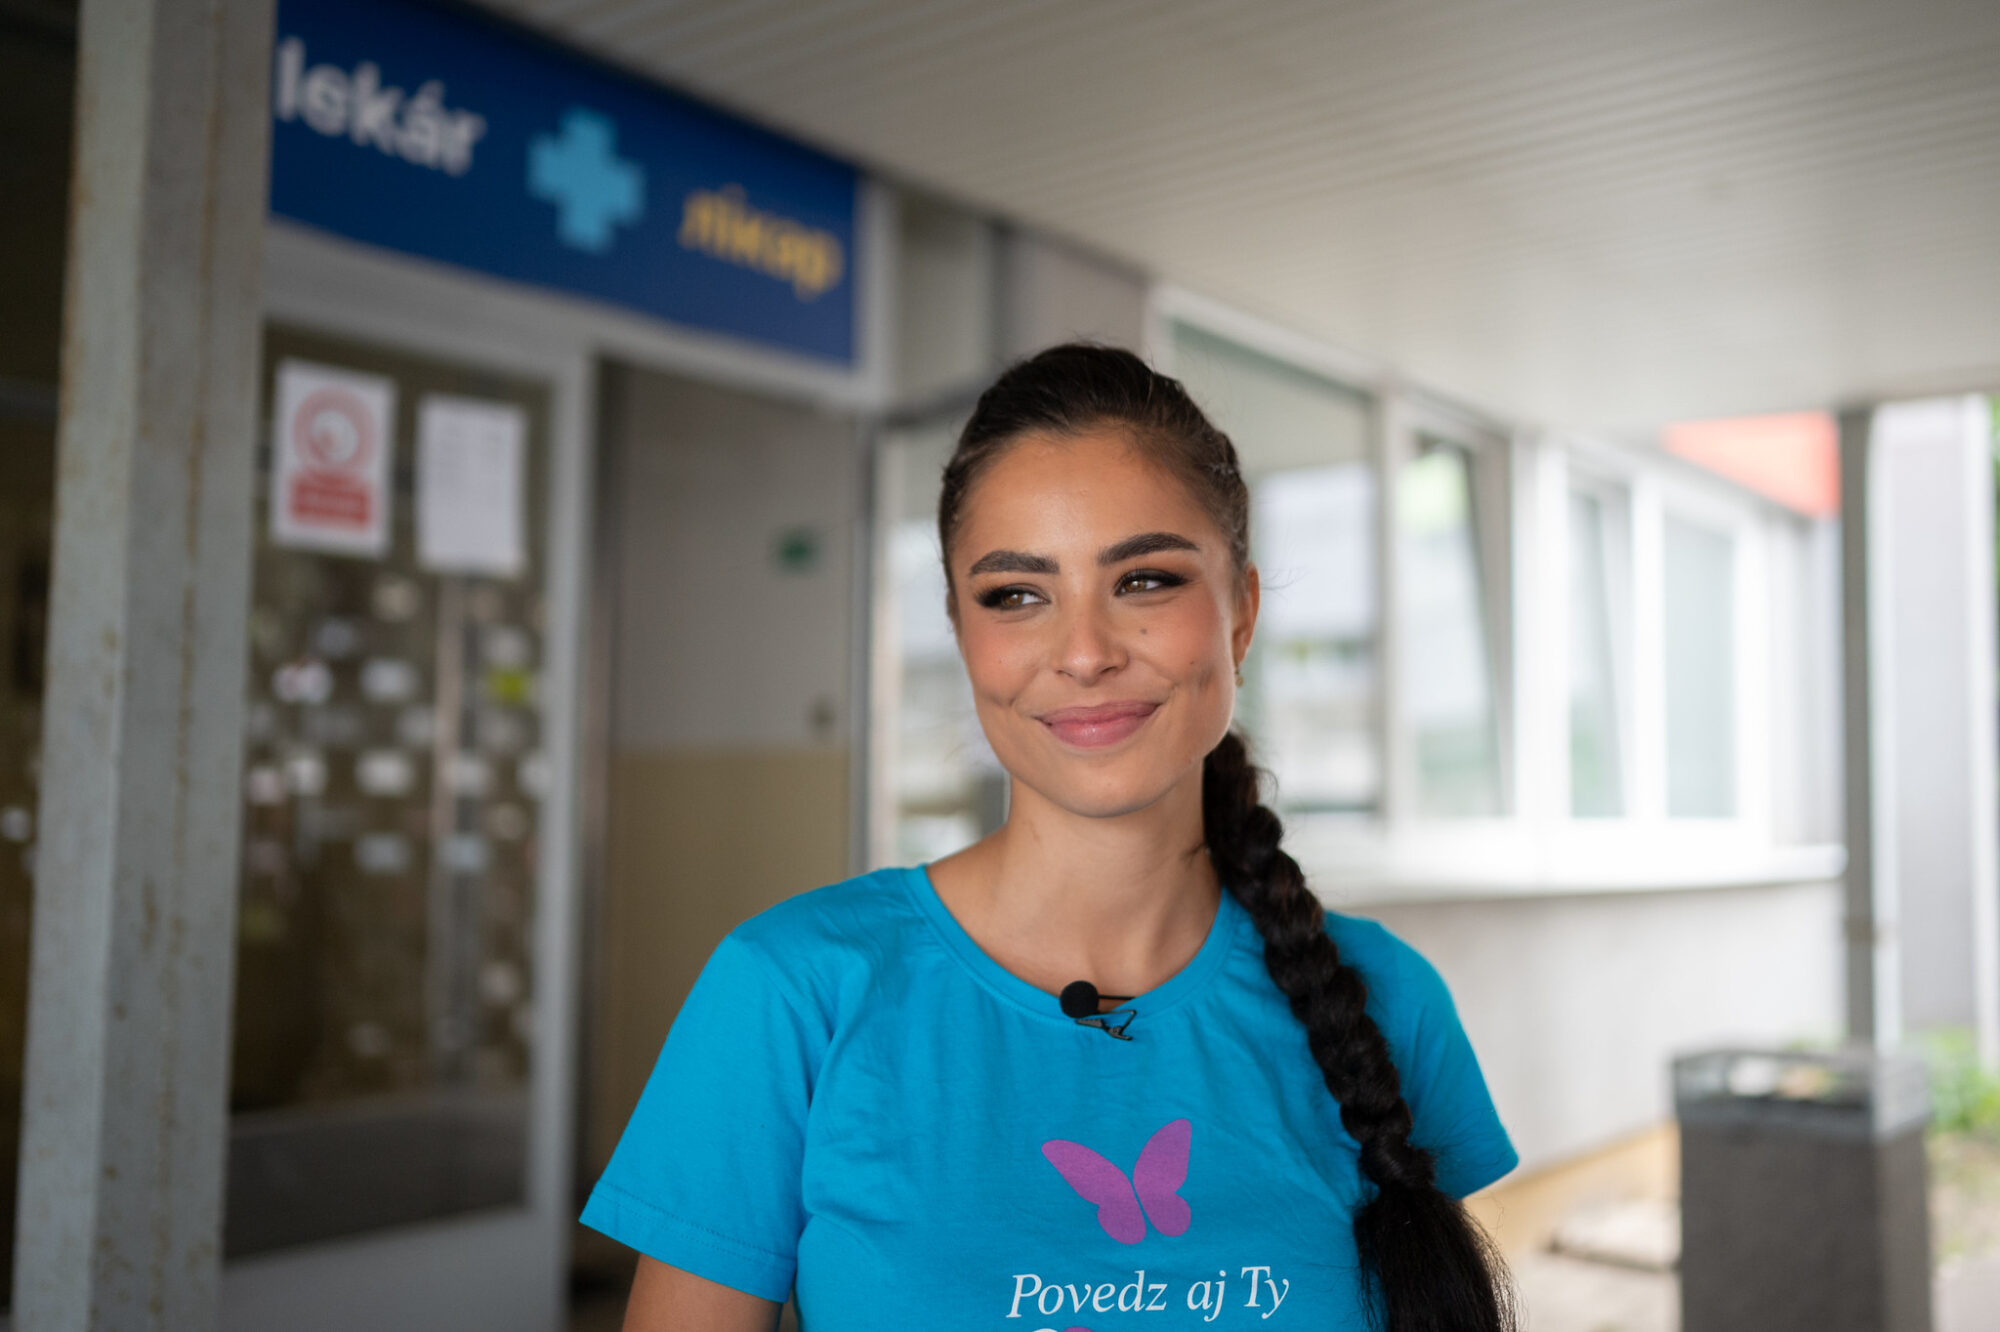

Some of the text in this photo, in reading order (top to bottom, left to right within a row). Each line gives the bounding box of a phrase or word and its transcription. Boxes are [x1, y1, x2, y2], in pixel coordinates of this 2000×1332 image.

[277, 37, 487, 176] lekár
[1005, 1265, 1290, 1322] Povedz aj Ty
